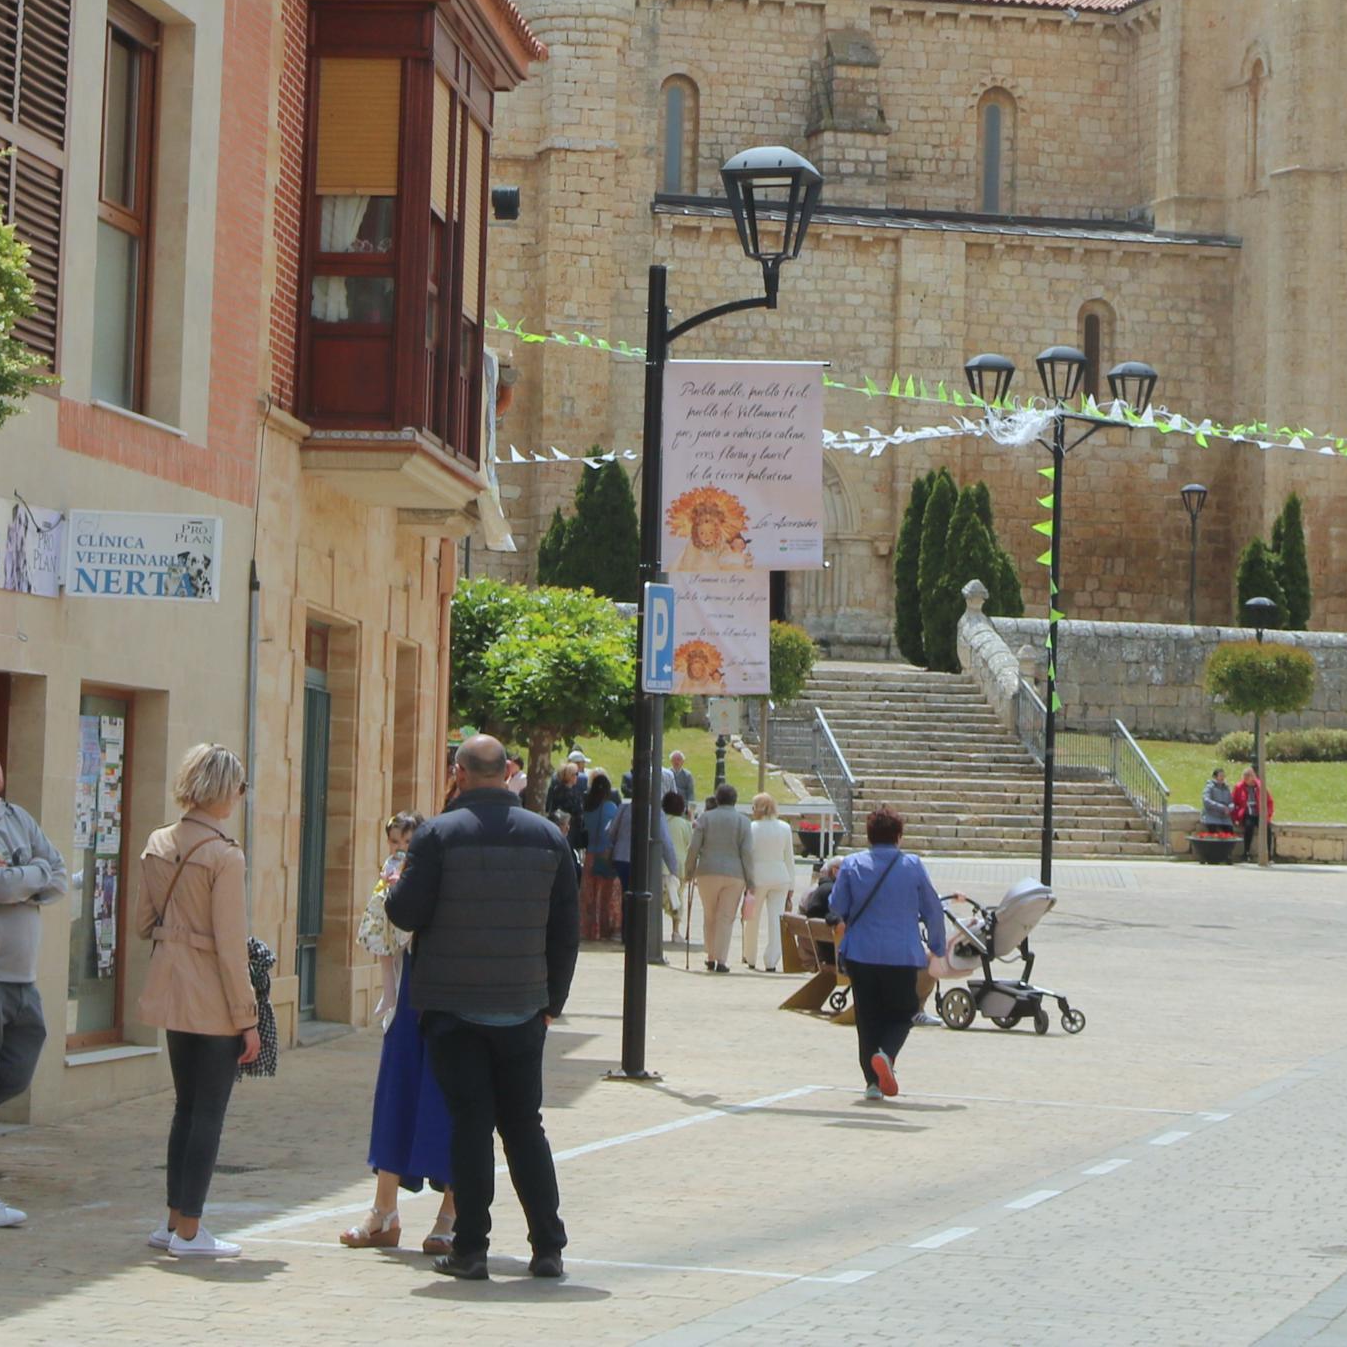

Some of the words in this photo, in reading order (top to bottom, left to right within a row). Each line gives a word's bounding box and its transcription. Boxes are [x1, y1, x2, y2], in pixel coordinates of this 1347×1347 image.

[181, 523, 209, 534] PRO
[77, 532, 145, 550] CLÍNICA
[175, 533, 213, 544] PLAN
[73, 567, 196, 598] NERTA
[651, 597, 669, 678] P
